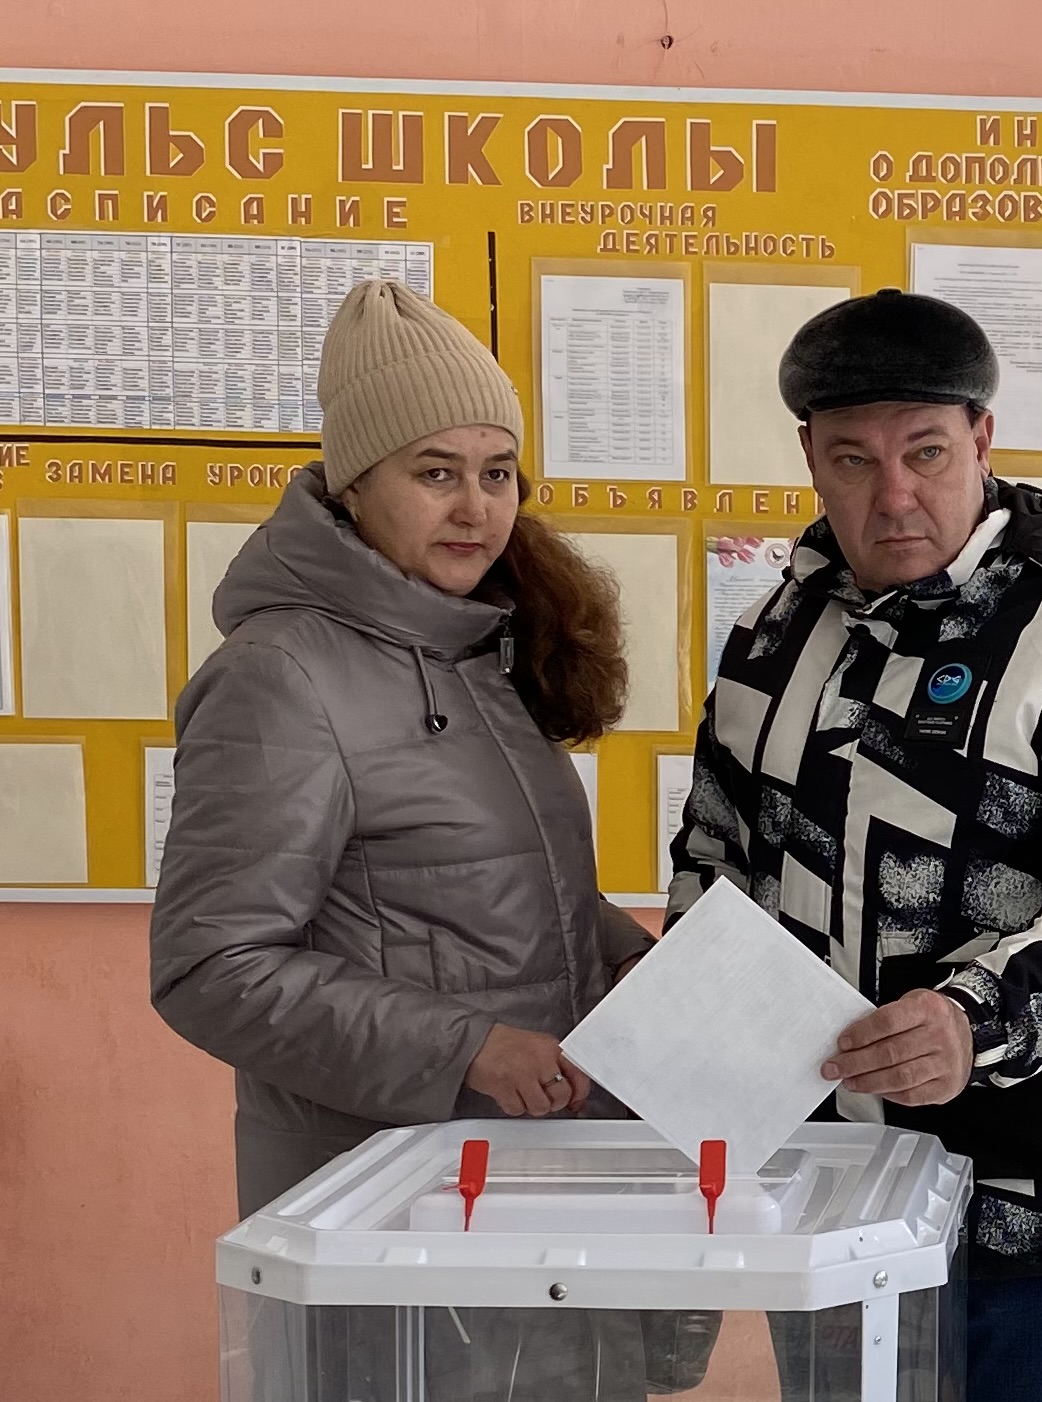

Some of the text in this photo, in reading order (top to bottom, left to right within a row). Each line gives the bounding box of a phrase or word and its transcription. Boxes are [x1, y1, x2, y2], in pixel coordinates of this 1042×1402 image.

[338, 108, 777, 193] ШКОЛЫ
[869, 150, 894, 183] О
[0, 188, 408, 229] АСПИСАНИЕ
[517, 200, 717, 228] ВНЕУРОЧНАЯ
[597, 230, 835, 260] ДЕЯТЕЛЬНОСТЬ
[45, 459, 177, 486] ЗАМЕНА
